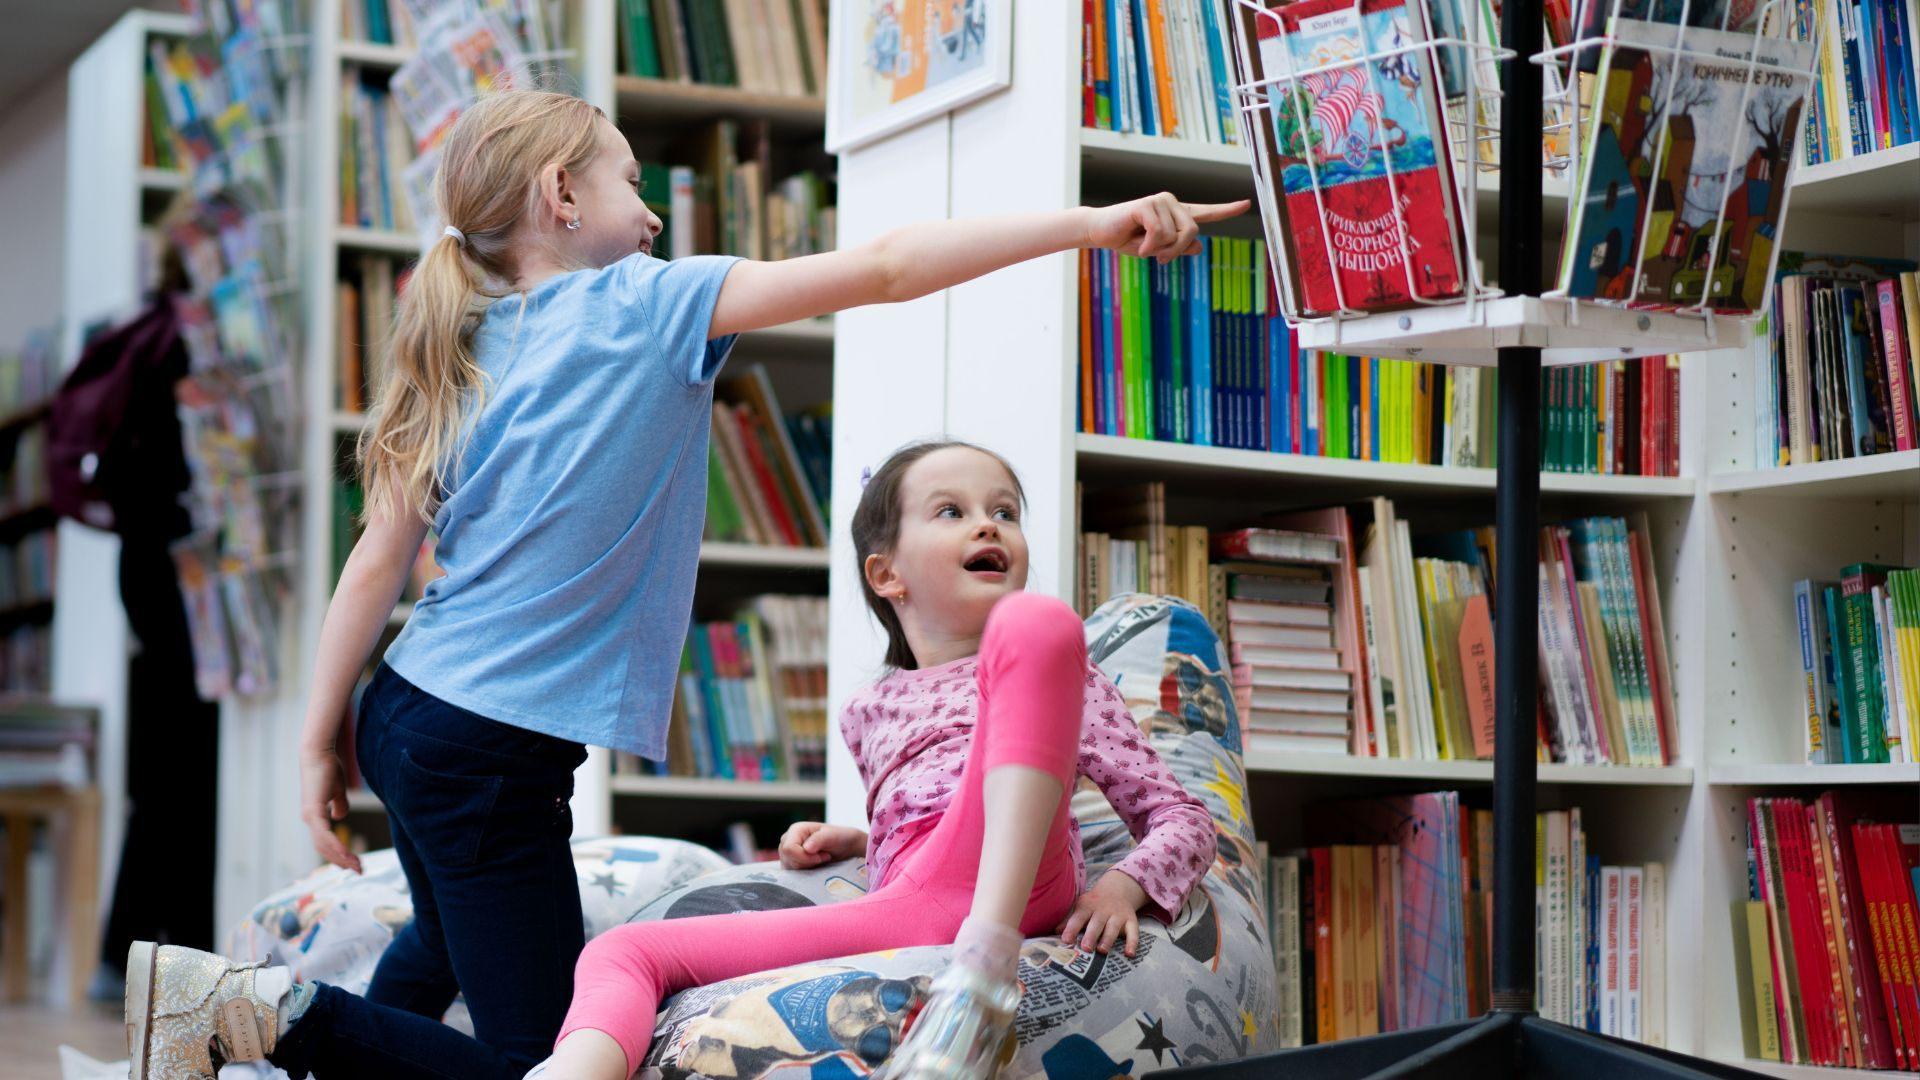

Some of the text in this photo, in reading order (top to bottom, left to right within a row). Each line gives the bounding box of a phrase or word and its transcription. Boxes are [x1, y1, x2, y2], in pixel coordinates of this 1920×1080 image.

[1693, 63, 1794, 89] КОРИЧНЕВЕ УТРО
[1068, 953, 1093, 975] ONE
